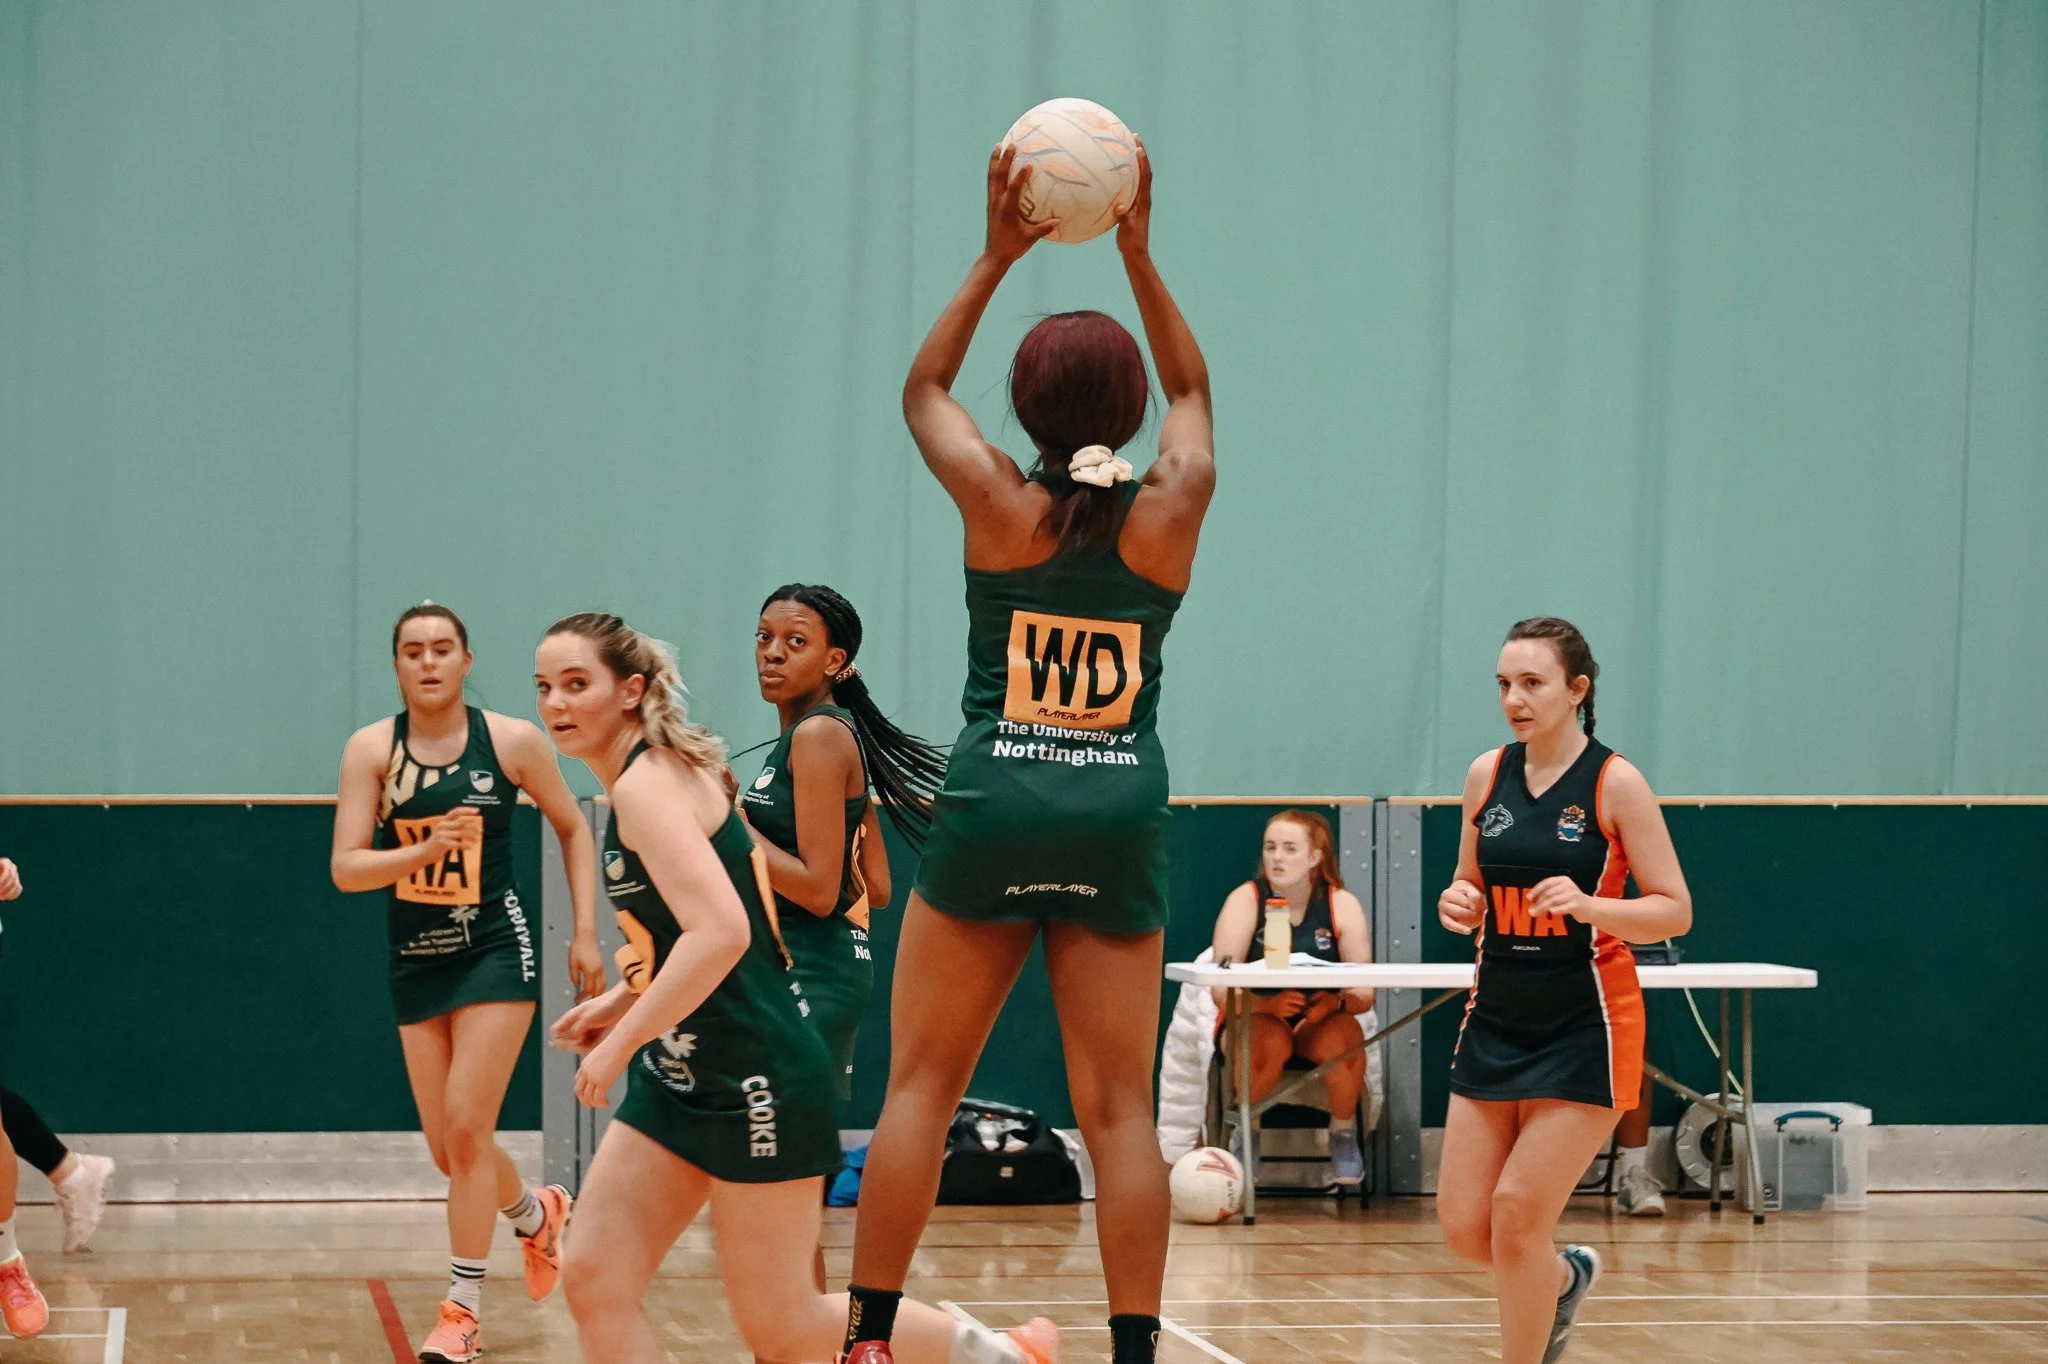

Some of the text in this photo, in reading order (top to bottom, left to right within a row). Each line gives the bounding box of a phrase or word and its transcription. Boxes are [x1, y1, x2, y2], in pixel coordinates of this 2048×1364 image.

[1026, 624, 1127, 709] WD
[1037, 708, 1100, 721] PLAYERLAYER
[997, 720, 1137, 745] The University of
[992, 740, 1139, 766] Nottingham
[1005, 883, 1098, 898] PLAYERLAYER
[740, 1075, 777, 1158] COOKE
